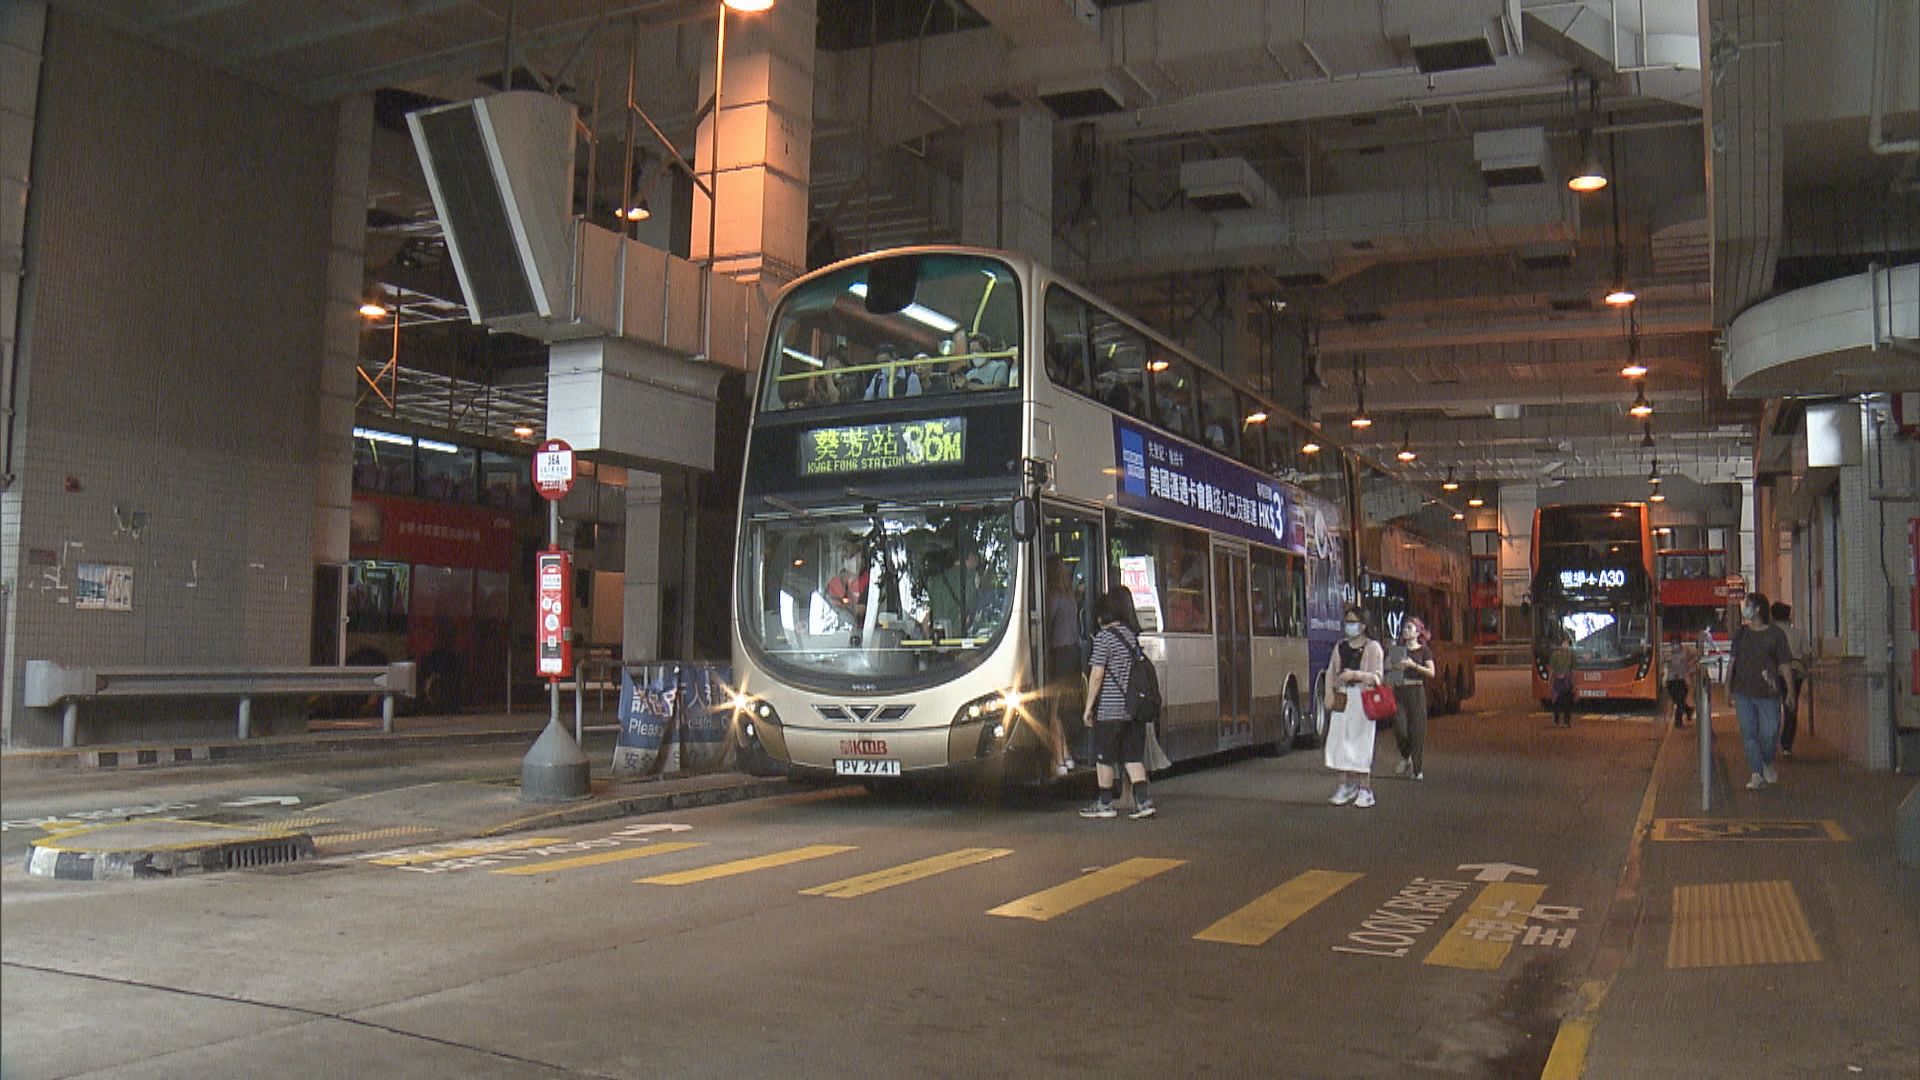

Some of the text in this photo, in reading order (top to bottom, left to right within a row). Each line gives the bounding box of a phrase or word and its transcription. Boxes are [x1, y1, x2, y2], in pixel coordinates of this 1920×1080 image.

[813, 421, 962, 463] 葵芳站 36M
[861, 455, 904, 470] STATION
[1599, 570, 1625, 587] A30
[842, 761, 895, 774] PV 2741
[1331, 877, 1471, 958] LOOK RIGHT
